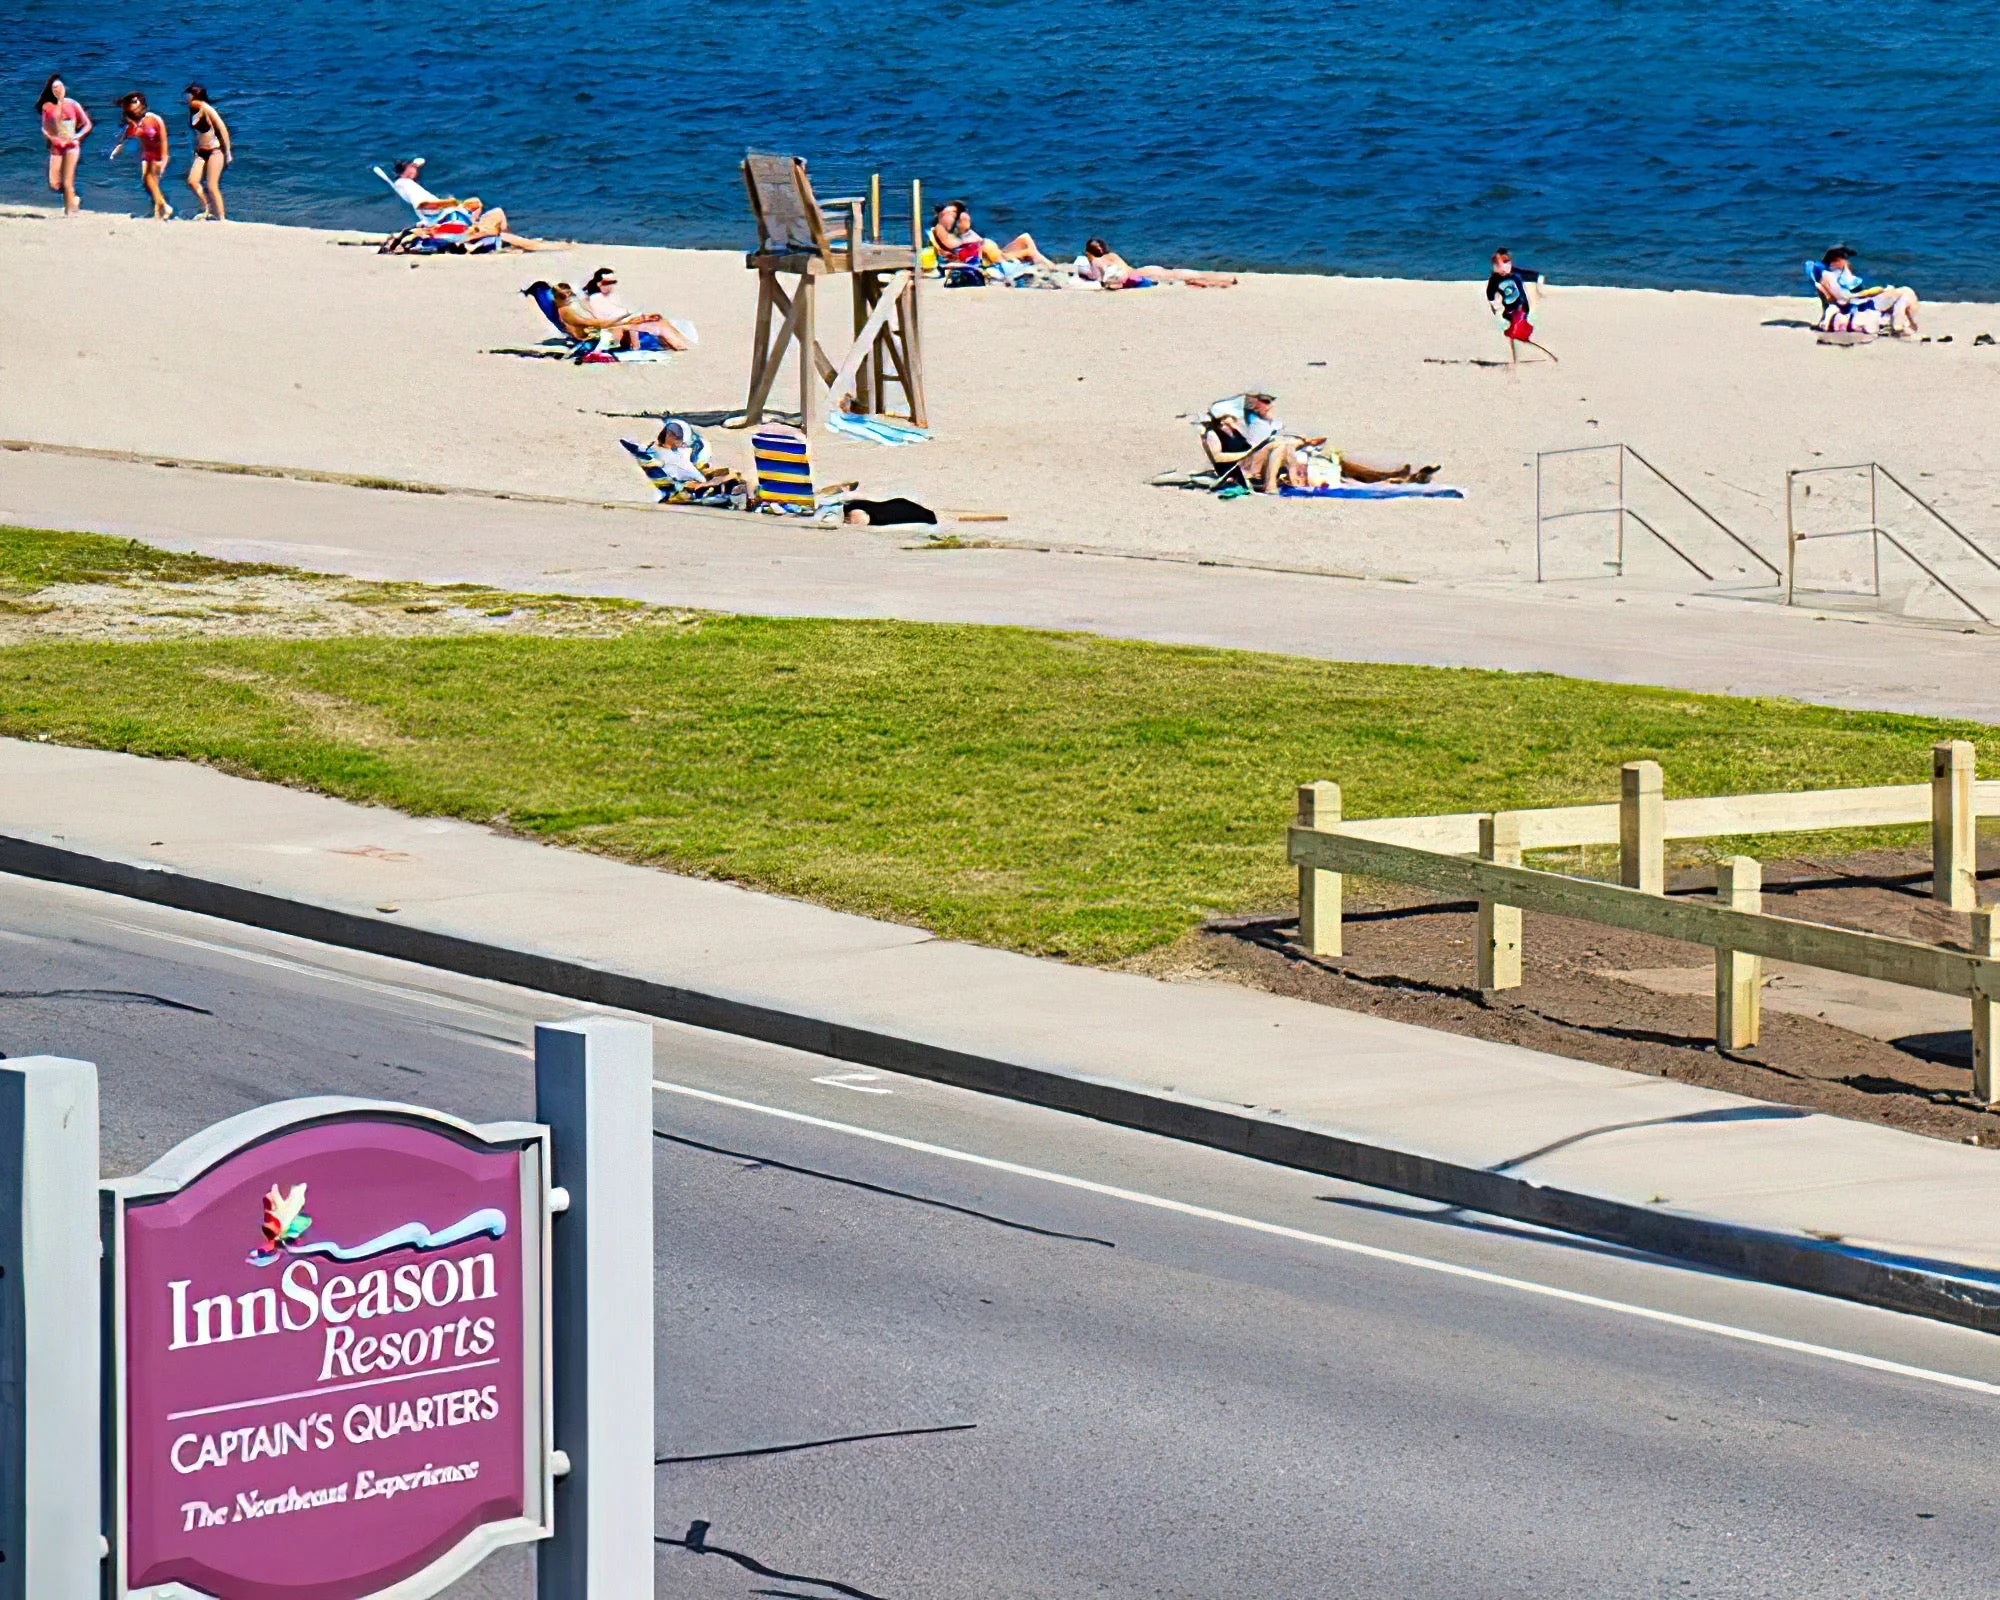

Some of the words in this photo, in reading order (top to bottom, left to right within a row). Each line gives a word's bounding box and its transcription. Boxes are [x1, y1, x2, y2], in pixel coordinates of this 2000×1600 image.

[168, 1253, 498, 1350] InnSeason
[317, 1316, 496, 1381] Resorts
[170, 1413, 335, 1474] CAPTAIN'S
[343, 1385, 499, 1444] QUARTERS
[180, 1501, 229, 1532] The
